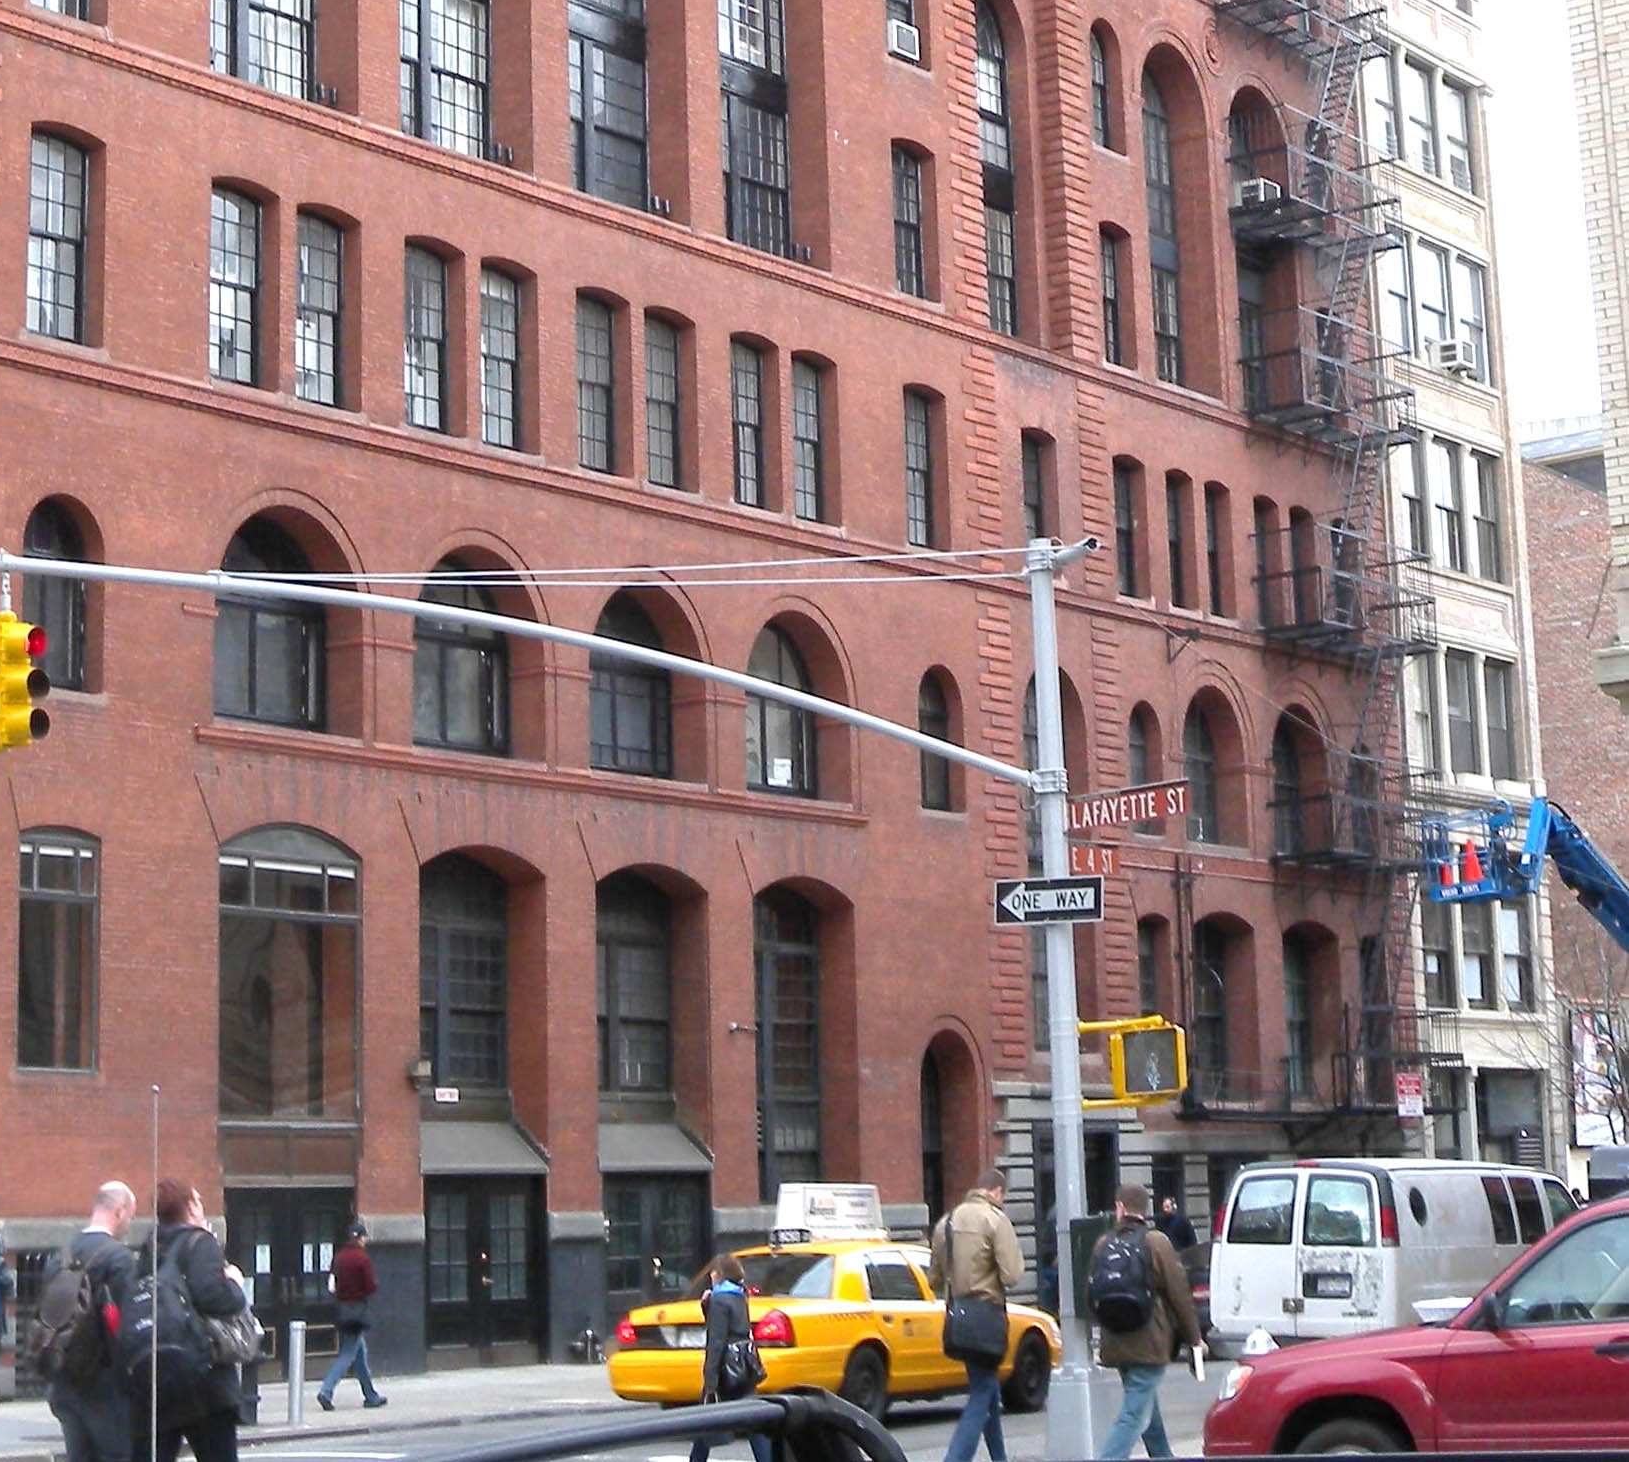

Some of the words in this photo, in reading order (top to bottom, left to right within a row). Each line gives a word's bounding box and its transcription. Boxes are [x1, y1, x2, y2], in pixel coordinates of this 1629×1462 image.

[1071, 792, 1157, 829] LAFAYETTE
[1167, 787, 1185, 814] ST
[1072, 847, 1082, 872] E
[1087, 848, 1095, 872] 4
[1101, 849, 1112, 874] ST
[1012, 893, 1042, 911] ONE
[1055, 890, 1088, 908] WAY
